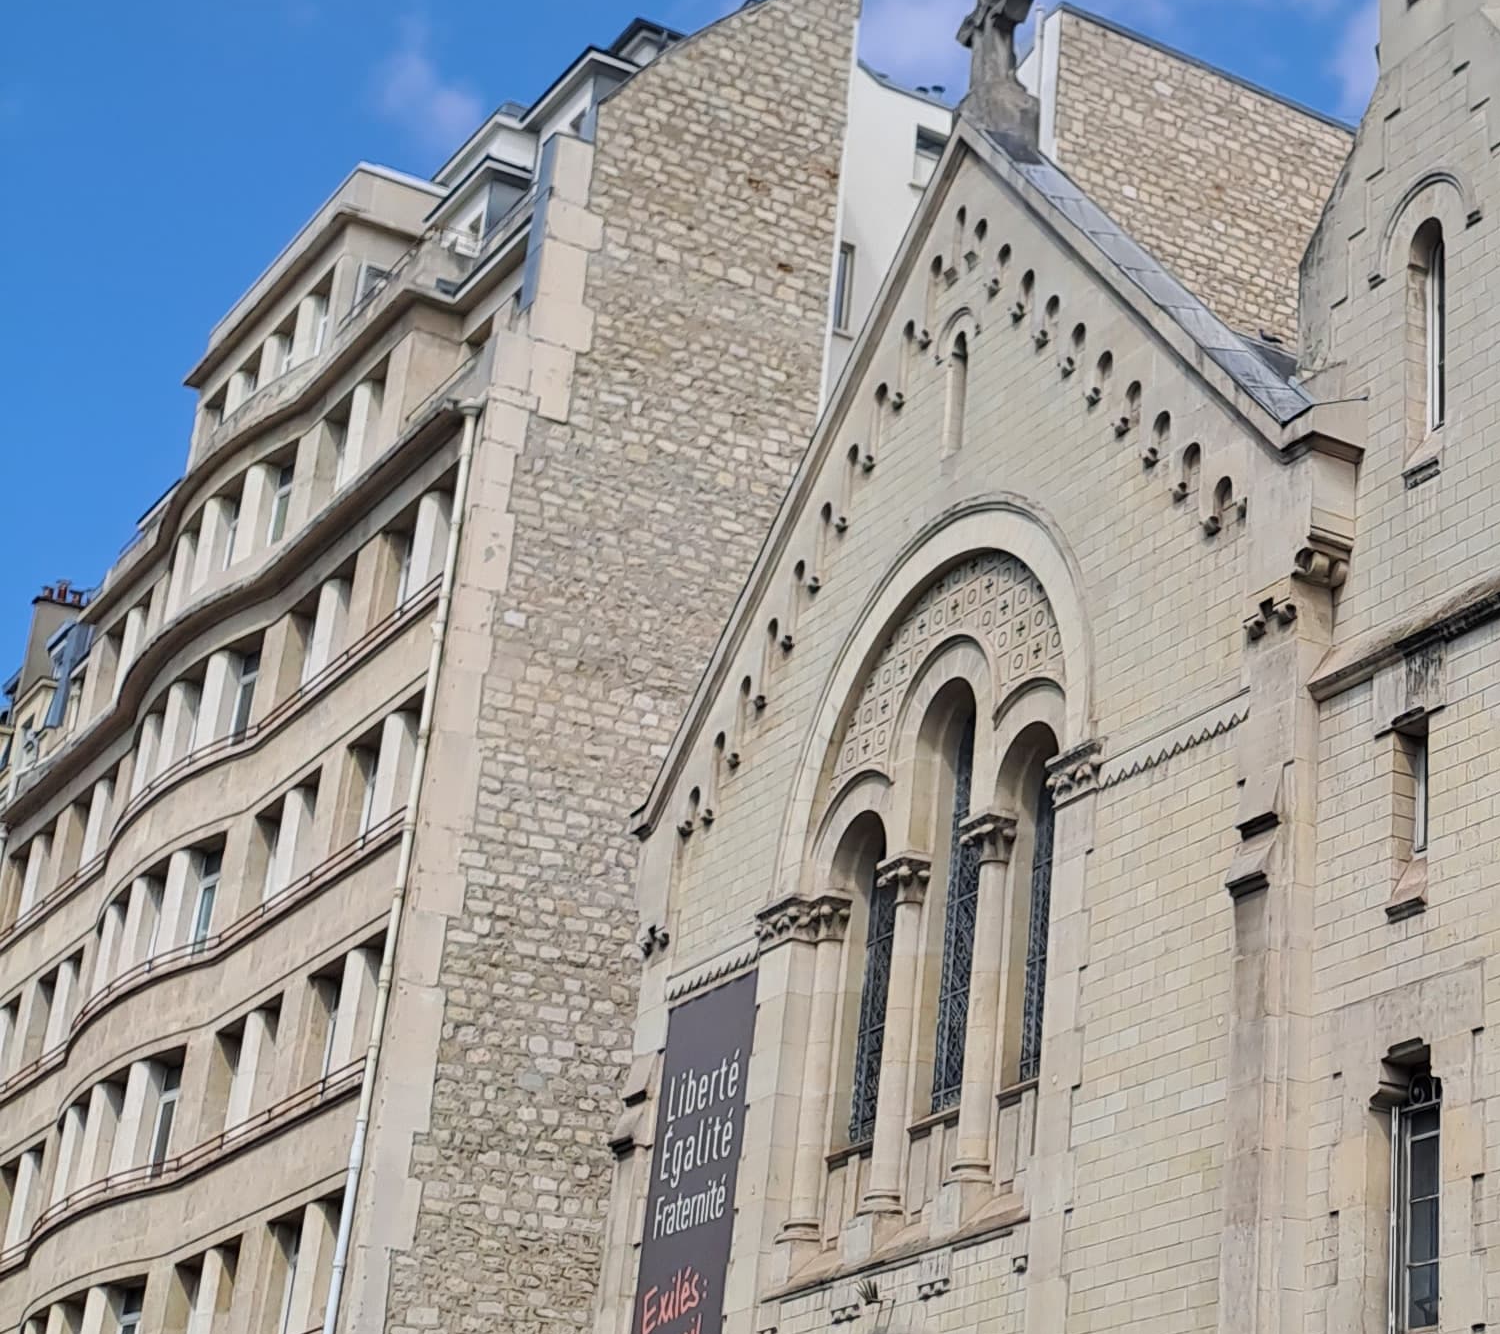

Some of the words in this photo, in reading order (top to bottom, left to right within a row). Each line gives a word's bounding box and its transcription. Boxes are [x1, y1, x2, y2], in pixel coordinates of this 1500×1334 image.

[667, 1048, 740, 1122] Liberté
[659, 1107, 734, 1189] Égalité
[653, 1173, 727, 1240] Fraternité
